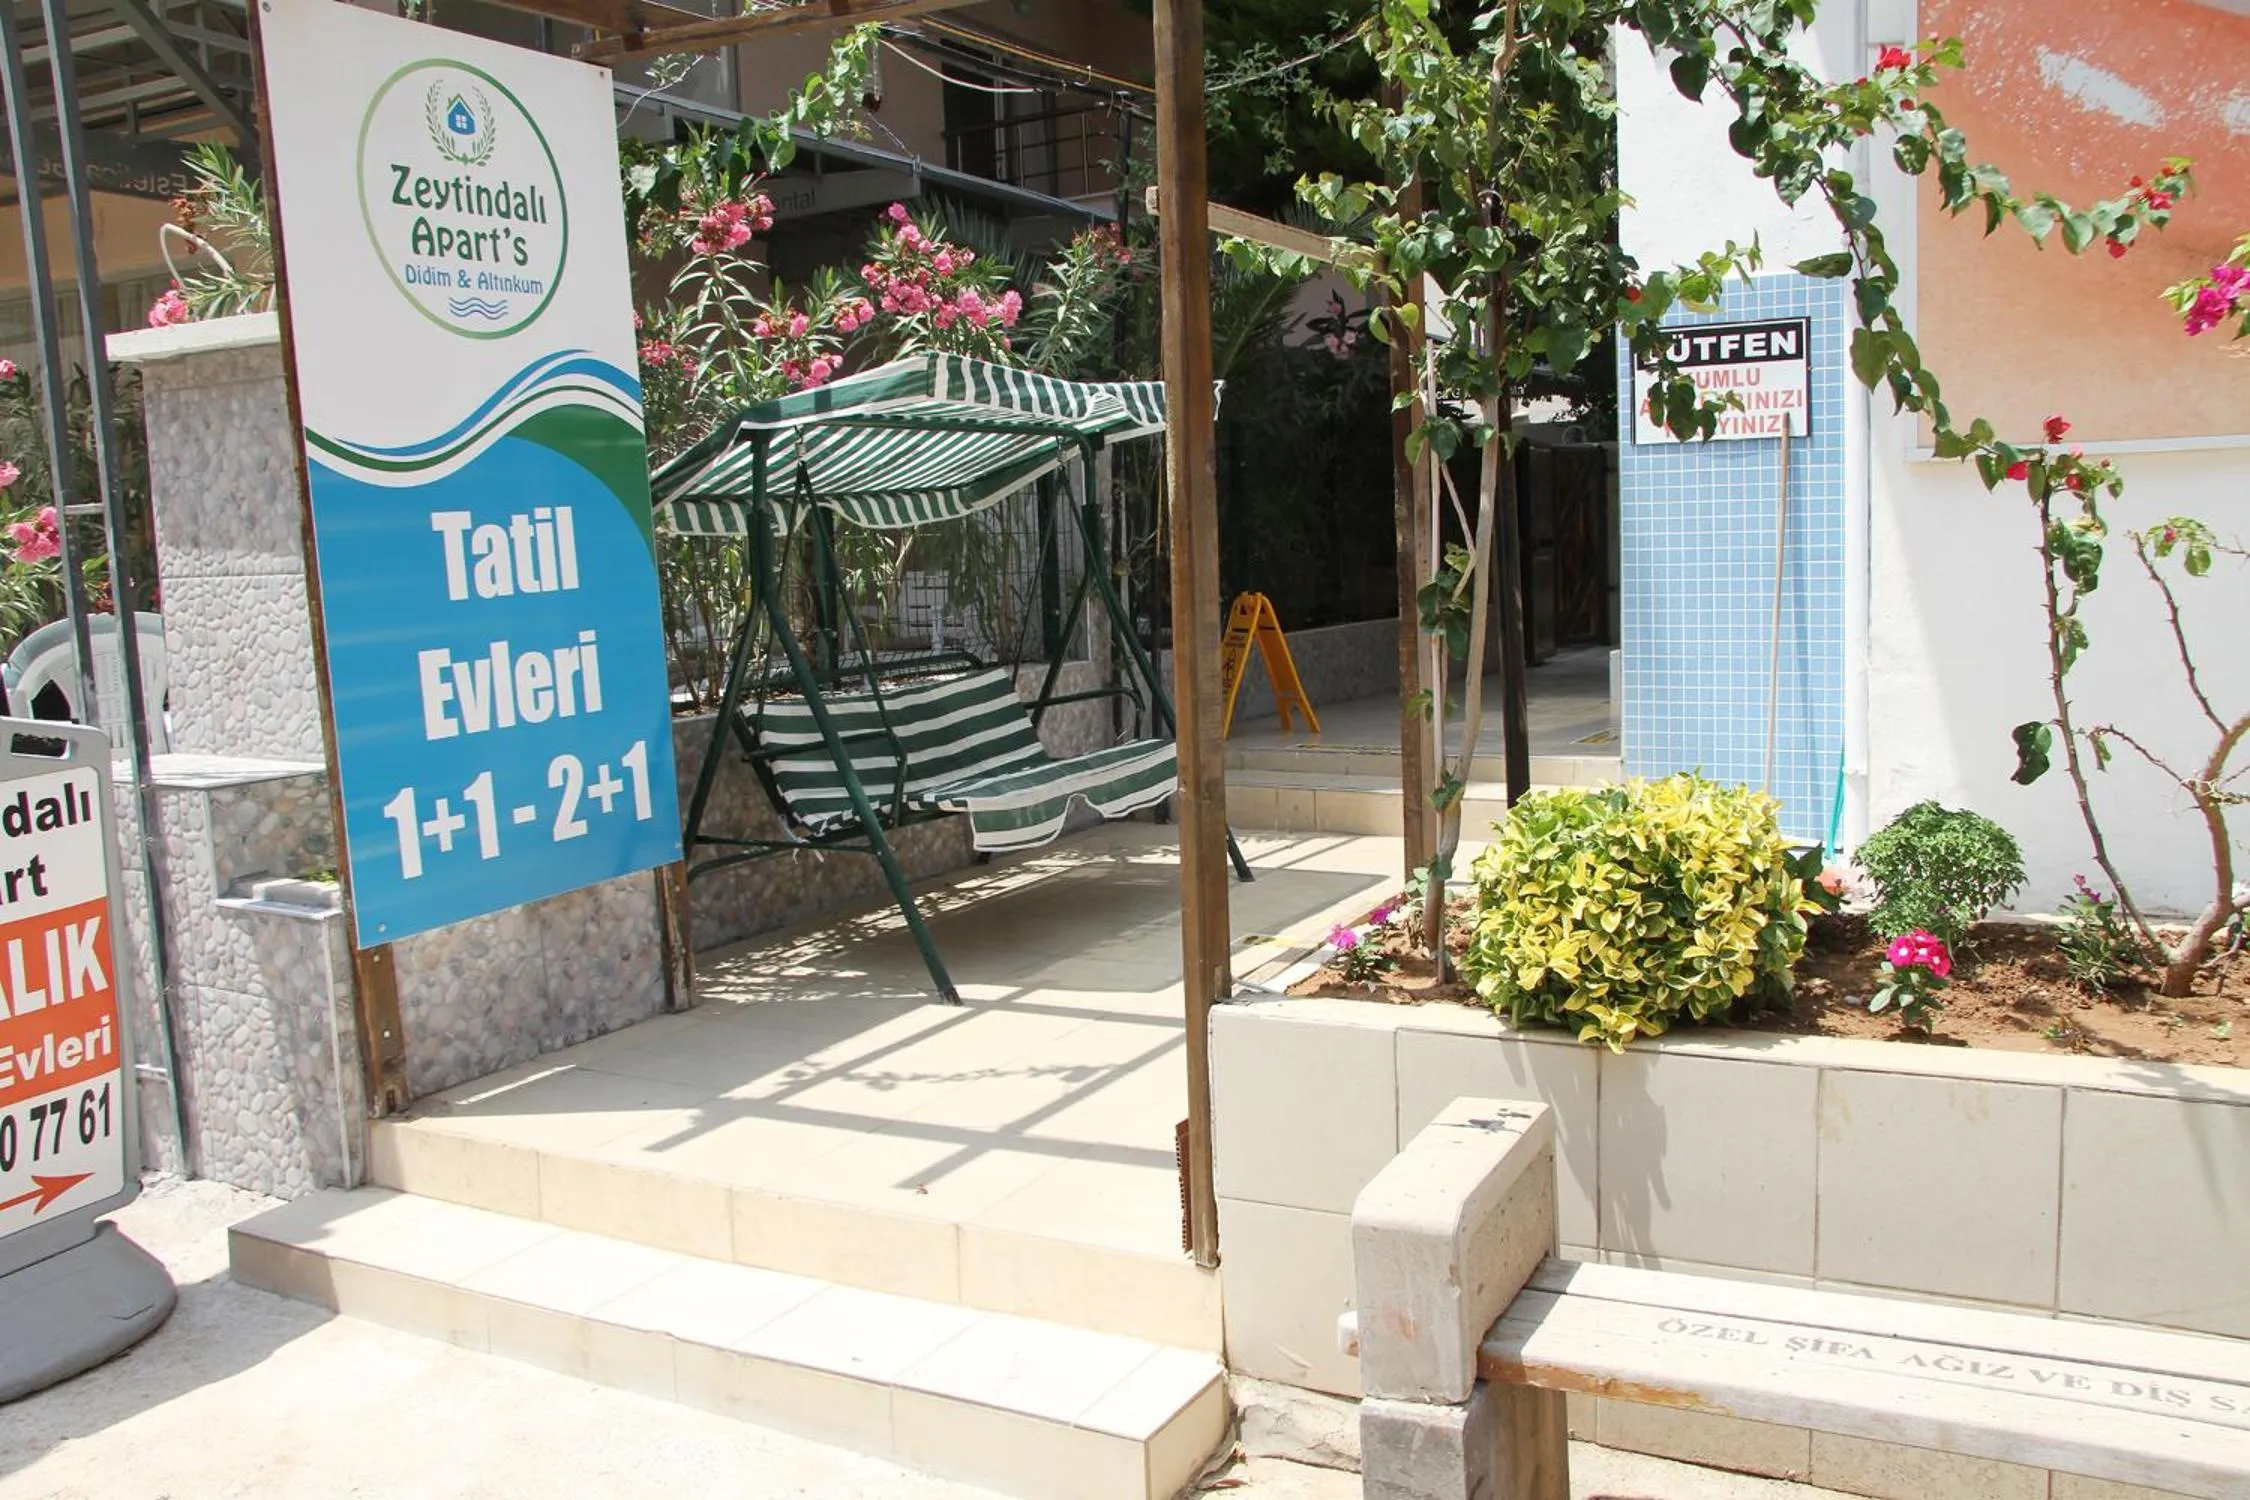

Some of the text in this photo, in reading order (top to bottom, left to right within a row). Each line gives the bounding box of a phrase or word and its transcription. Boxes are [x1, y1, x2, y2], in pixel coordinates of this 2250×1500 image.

[390, 163, 547, 224] Zeytindalı
[412, 216, 529, 266] Apart's
[405, 264, 543, 296] Didim & Altınkum
[1690, 367, 1761, 389] UMLU
[430, 505, 580, 601] Tatil
[418, 629, 603, 741] Evleri
[2, 782, 92, 838] dalı
[383, 740, 652, 880] 1+1 - 2+1
[0, 1014, 112, 1090] Evleri
[30, 1097, 68, 1162] 77
[79, 1082, 110, 1145] 61
[1656, 1318, 1769, 1346] ÖZEL
[1898, 1353, 2015, 1380] AĞIZ
[2029, 1368, 2092, 1391] VE
[2208, 1395, 2250, 1414] S
